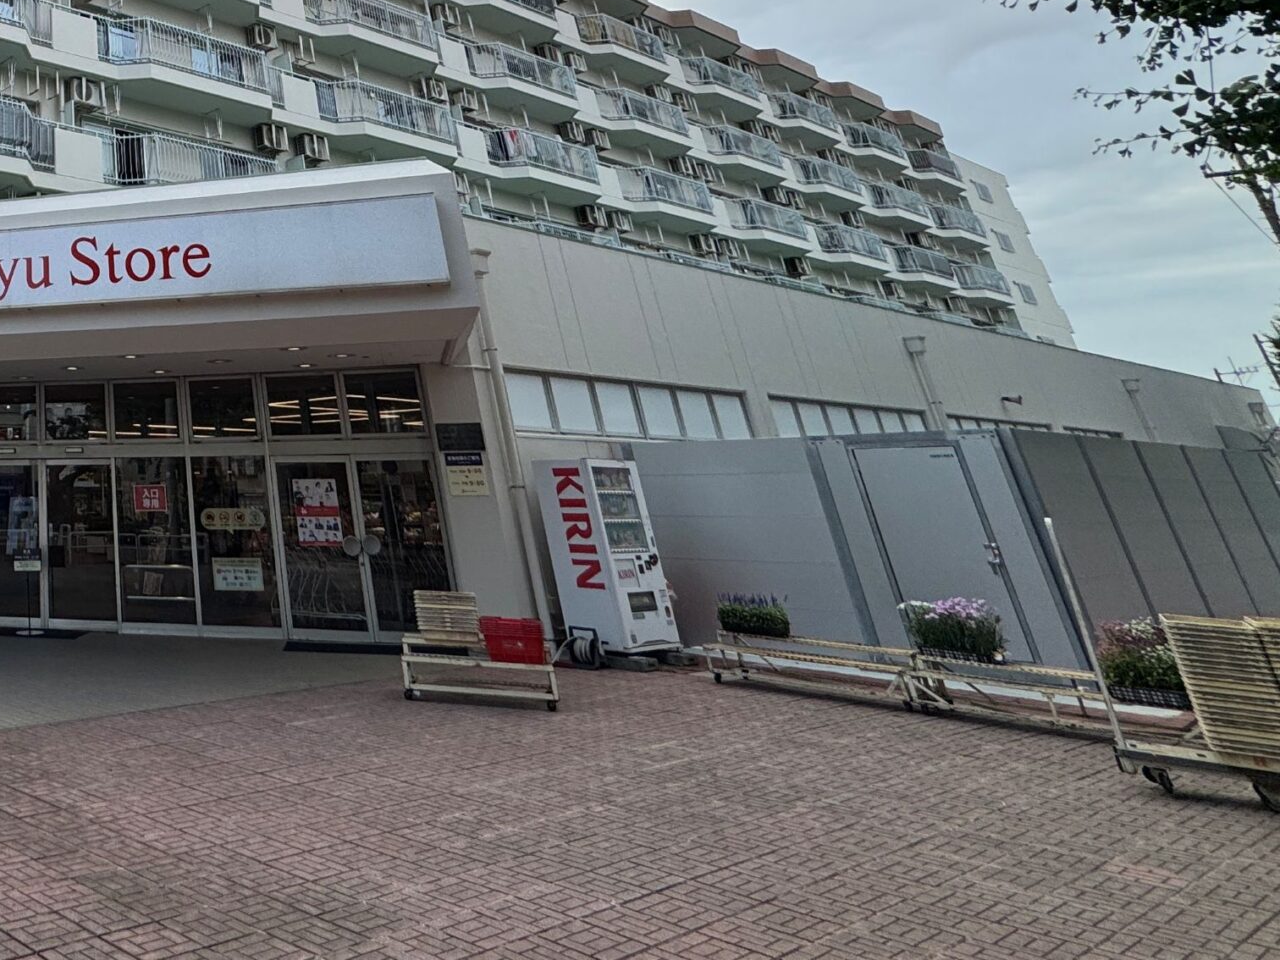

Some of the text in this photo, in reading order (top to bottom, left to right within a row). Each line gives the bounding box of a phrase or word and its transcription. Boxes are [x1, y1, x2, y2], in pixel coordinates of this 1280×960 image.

[69, 236, 212, 287] Store
[142, 488, 159, 498] 入口
[142, 499, 159, 508] 専用
[552, 467, 606, 590] KIRIN
[618, 568, 635, 580] KIRIN
